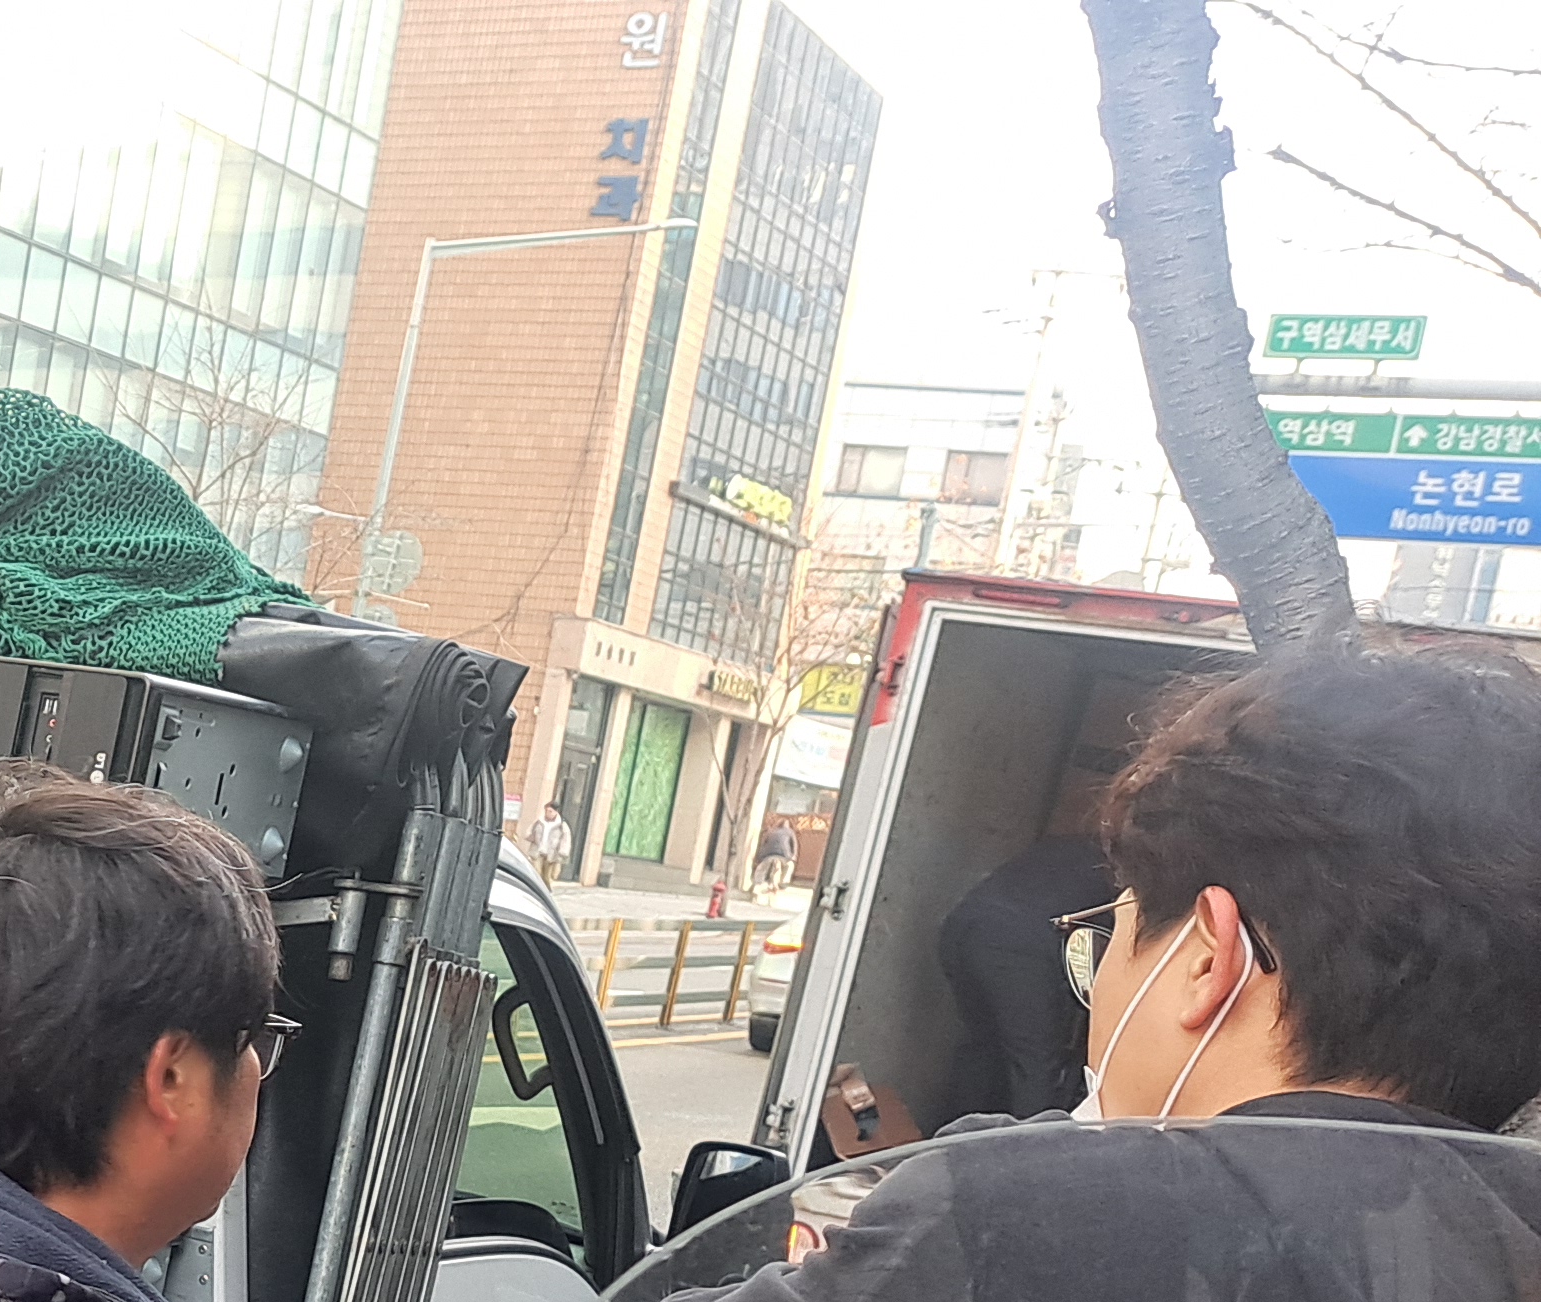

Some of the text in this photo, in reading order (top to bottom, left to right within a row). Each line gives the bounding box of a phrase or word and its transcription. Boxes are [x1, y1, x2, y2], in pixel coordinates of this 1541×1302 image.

[590, 11, 669, 222] 원 치과
[1275, 318, 1416, 352] 구역삼세무서
[1276, 417, 1357, 447] 역삼역
[1410, 468, 1524, 509] 논현로
[1389, 506, 1533, 538] Nonhyeon-ro
